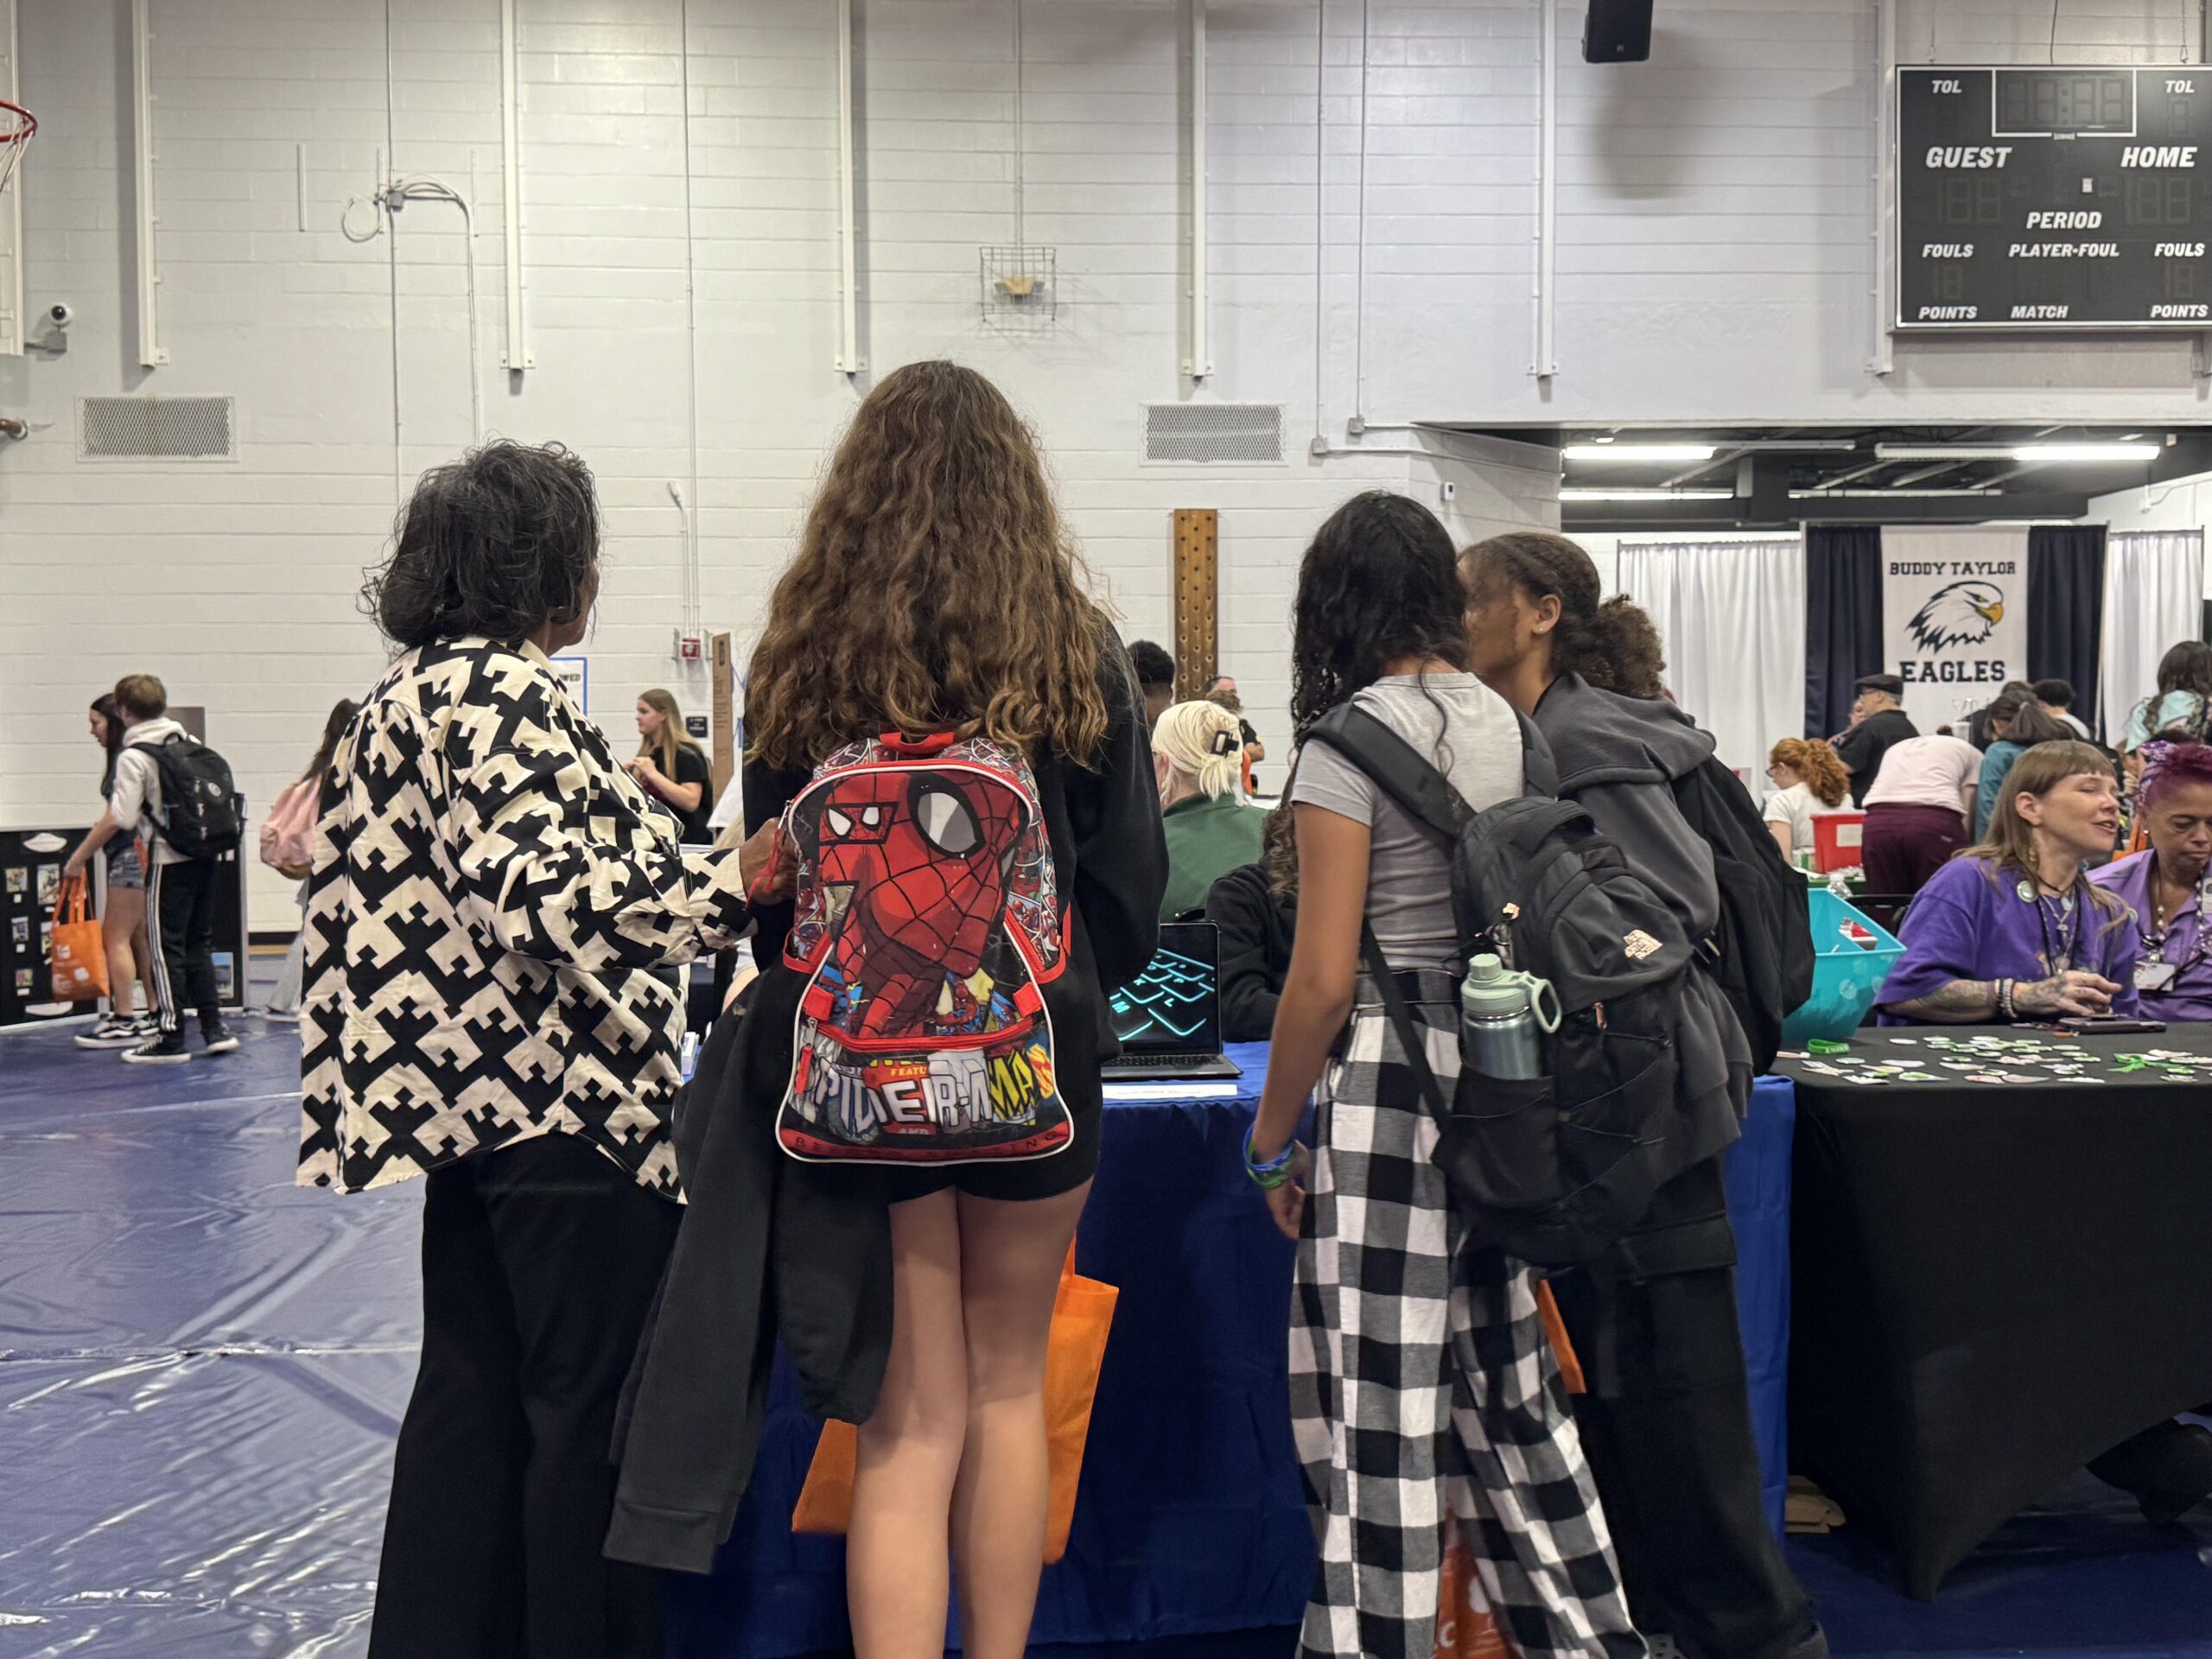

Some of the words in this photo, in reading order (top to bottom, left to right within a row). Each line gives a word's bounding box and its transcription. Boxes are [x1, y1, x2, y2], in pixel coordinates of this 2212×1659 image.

[1932, 79, 1962, 94] TOL
[2165, 79, 2195, 93] TOL
[1926, 146, 2012, 168] GUEST
[2120, 146, 2198, 168] HOME
[2026, 211, 2102, 229] PERIOD
[1922, 244, 1974, 258] FOULS
[2154, 242, 2206, 257] FOULS
[1918, 305, 1978, 320] POINTS
[2010, 305, 2069, 319] MATCH
[2150, 304, 2209, 318] POINTS
[1889, 562, 1947, 575] BUDDY
[1950, 561, 2016, 575] TAYLOR
[1899, 660, 2005, 683] EAGLES
